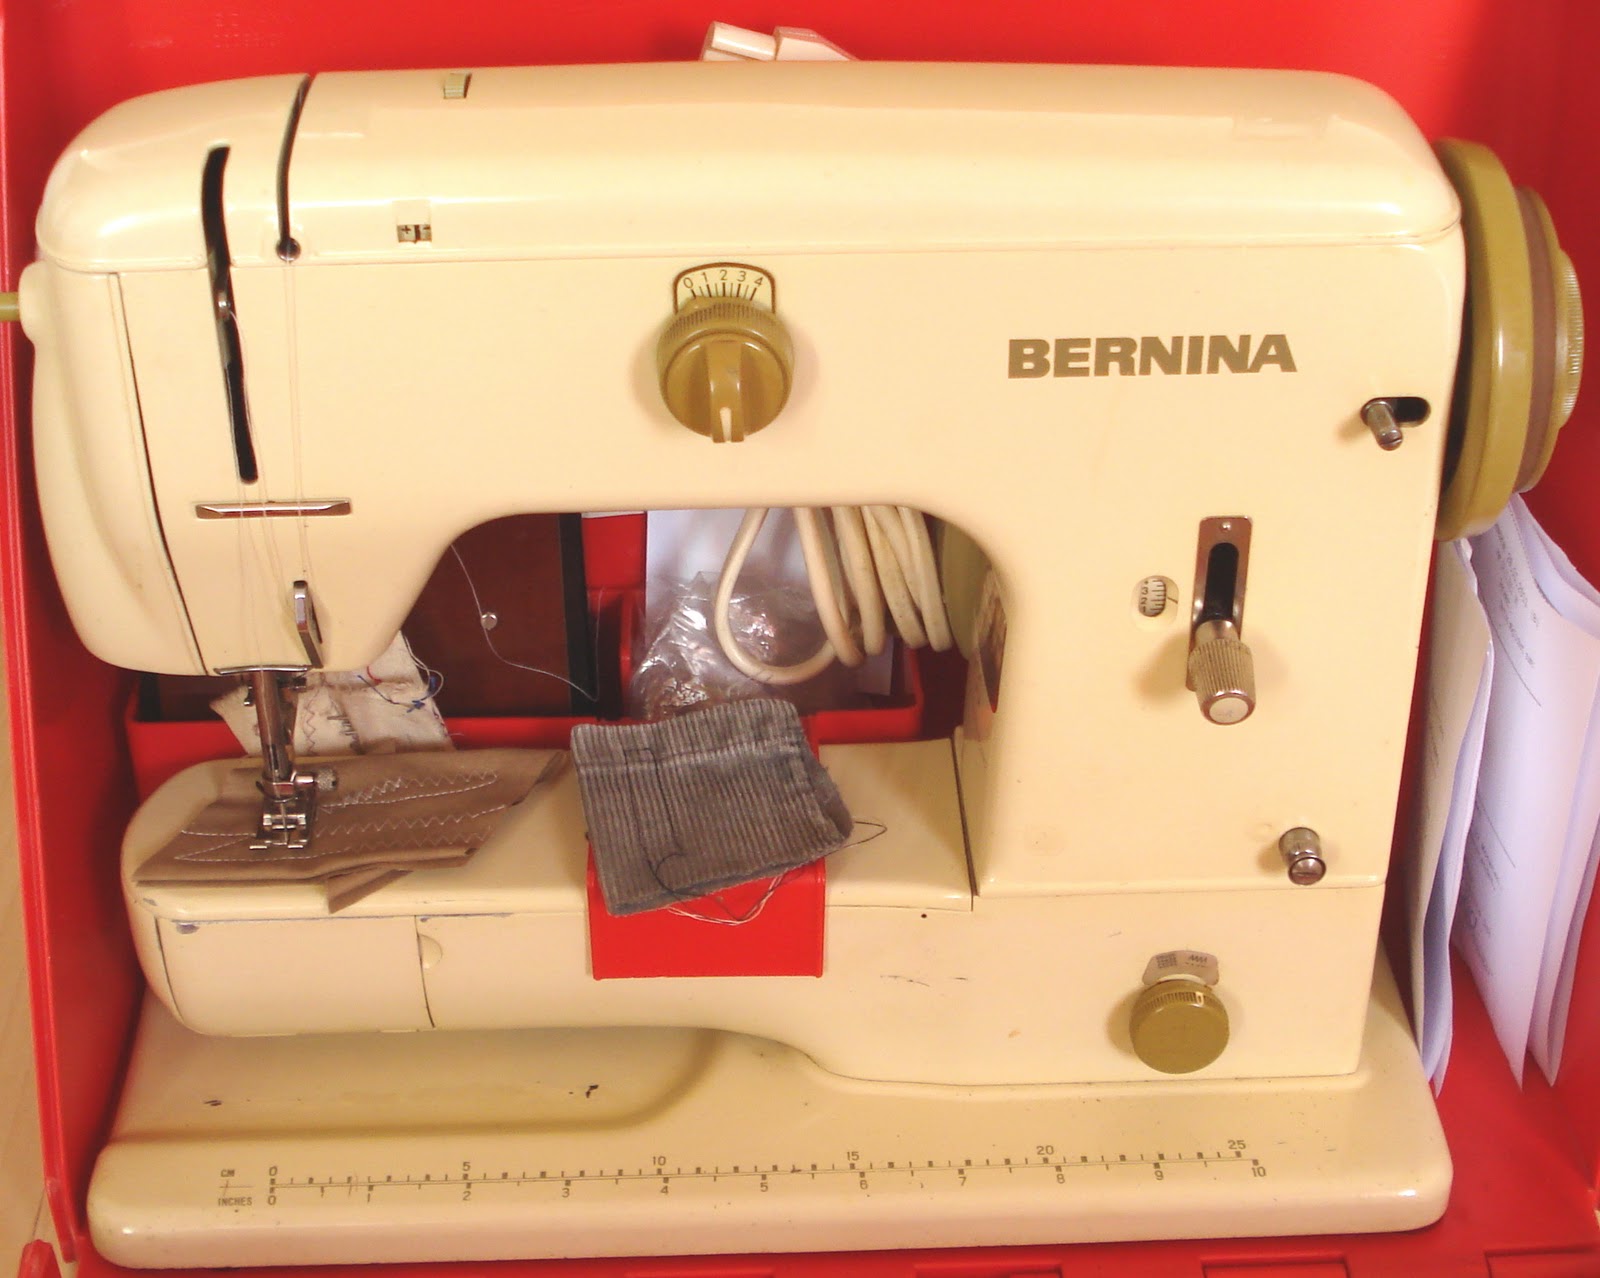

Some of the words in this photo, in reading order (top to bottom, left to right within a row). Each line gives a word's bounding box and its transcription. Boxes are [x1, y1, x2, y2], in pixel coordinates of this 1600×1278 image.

[683, 277, 694, 289] 0
[701, 272, 708, 283] 1
[720, 269, 728, 281] 2
[737, 270, 747, 282] 3
[754, 276, 764, 286] 4
[1007, 334, 1298, 379] BERNINA
[220, 1169, 235, 1178] CM
[268, 1166, 278, 1177] 0
[462, 1162, 471, 1172] 5
[652, 1156, 667, 1167] 10
[846, 1151, 860, 1161] 15
[1036, 1145, 1054, 1156] 20
[1227, 1140, 1247, 1150] 25
[217, 1197, 253, 1207] INCHES
[267, 1195, 277, 1206] 0
[462, 1191, 471, 1202] 2
[561, 1188, 571, 1199] 3
[660, 1185, 669, 1196] 4
[759, 1182, 769, 1193] 5
[859, 1179, 869, 1190] 6
[958, 1176, 967, 1187] 7
[1056, 1173, 1065, 1184] 8
[1154, 1170, 1164, 1181] 9
[1251, 1166, 1267, 1178] 10
